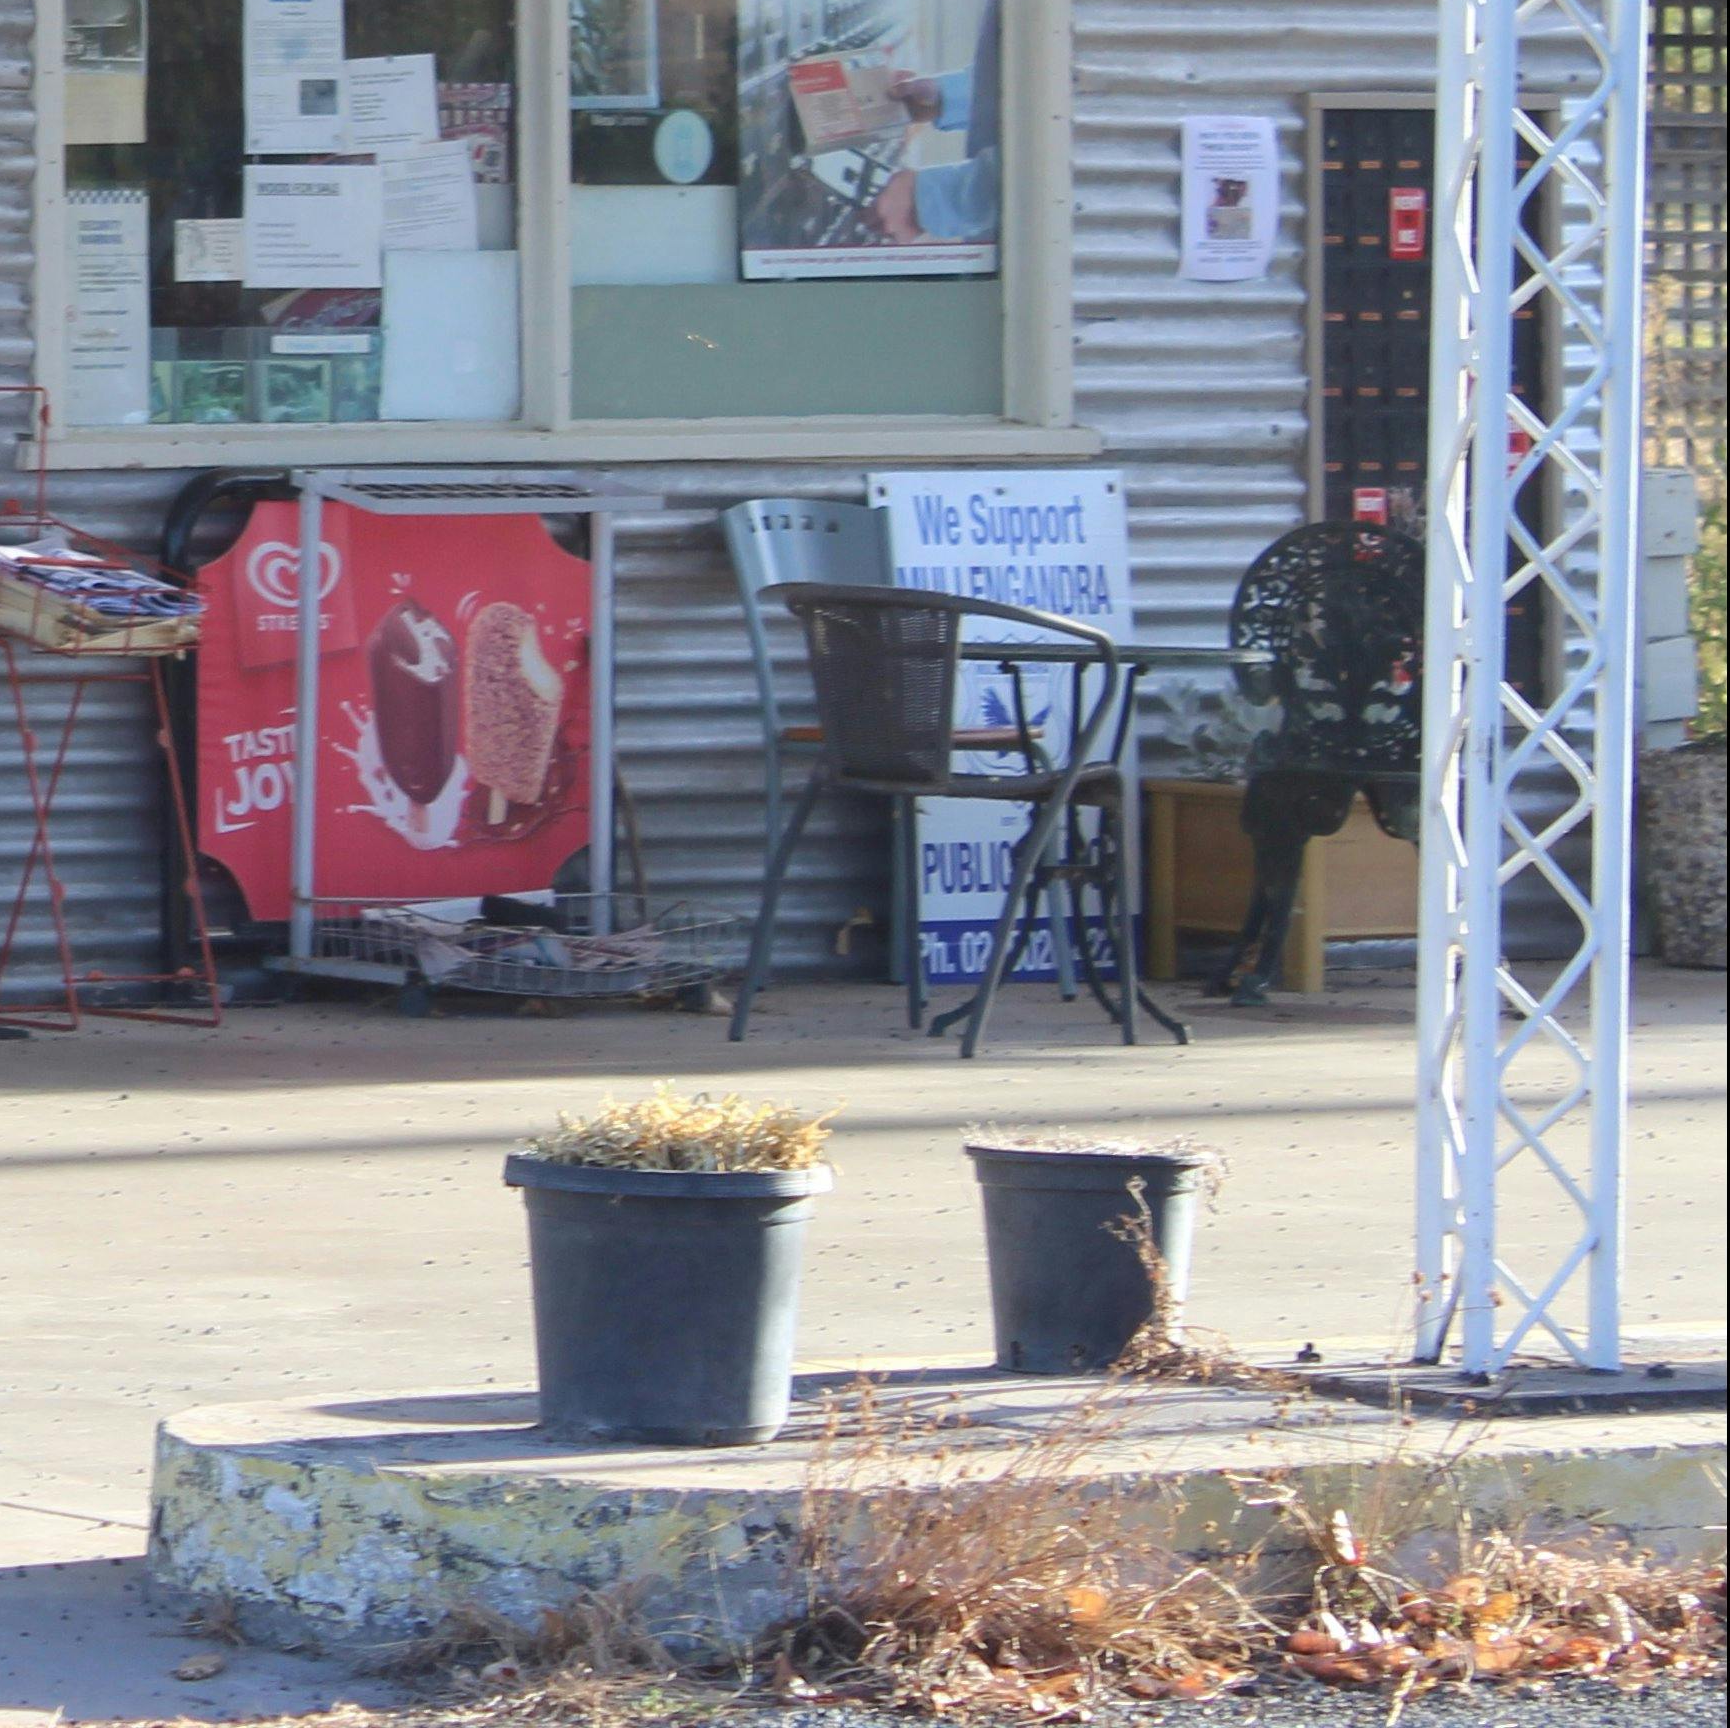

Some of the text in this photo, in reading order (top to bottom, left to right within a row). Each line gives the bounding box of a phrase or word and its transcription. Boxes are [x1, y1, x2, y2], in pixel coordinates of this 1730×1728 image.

[912, 493, 1087, 557] We Support
[257, 613, 332, 631] STRES
